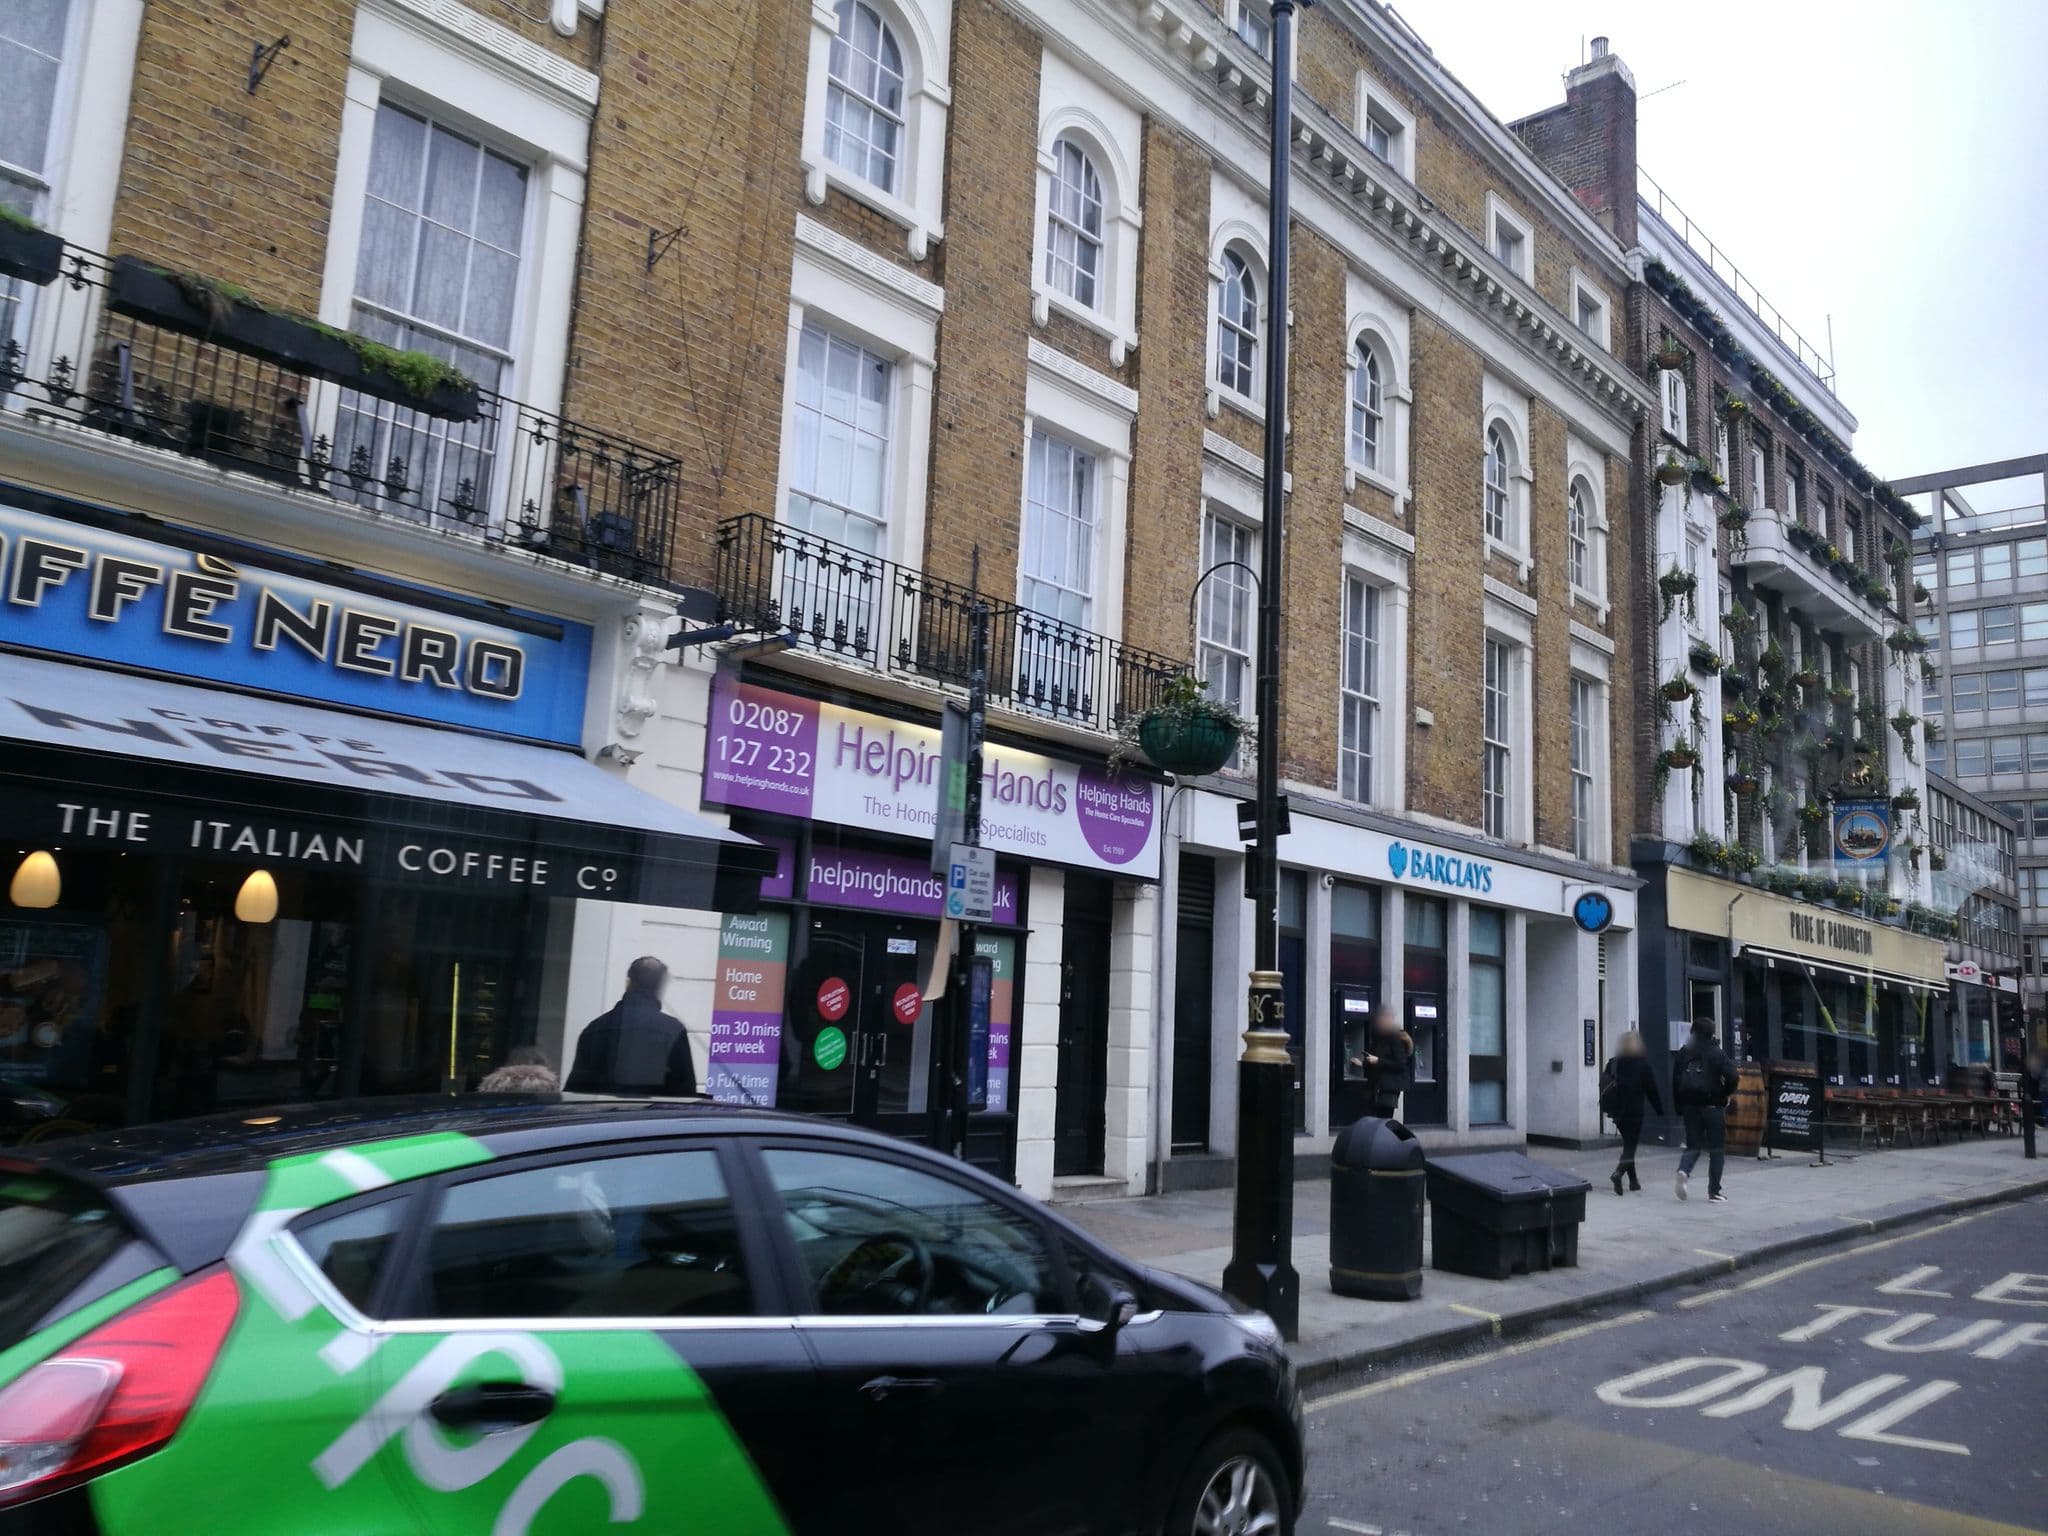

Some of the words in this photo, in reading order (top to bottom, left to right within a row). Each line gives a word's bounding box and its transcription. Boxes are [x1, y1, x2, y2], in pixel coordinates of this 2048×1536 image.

[0, 531, 240, 644] FFÈ
[254, 587, 525, 700] NERO
[730, 699, 804, 737] 02087
[8, 698, 566, 802] NERO
[717, 736, 762, 766] 127
[767, 746, 811, 777] 232
[837, 722, 942, 793] Helpin
[713, 771, 810, 796] www.helpinghands.co.uk
[1079, 784, 1118, 811] Helping
[1120, 793, 1151, 815] Hands
[864, 796, 891, 817] The
[896, 803, 938, 826] Home
[980, 818, 1047, 846] Specialists
[1085, 807, 1094, 817] The
[1109, 811, 1120, 822] Care
[57, 803, 150, 842] THE
[191, 820, 364, 866] ITALIAN
[398, 844, 548, 887] COFFEE
[953, 867, 965, 889] P
[1411, 848, 1493, 893] BARCLAYS
[729, 916, 768, 932] Award
[1790, 911, 1814, 944] PRIDE
[1816, 918, 1826, 946] OF
[1828, 920, 1873, 956] PADDINGTON
[722, 932, 773, 953] Winning
[975, 942, 998, 954] ward
[726, 968, 762, 984] Home
[729, 986, 757, 1001] Care
[733, 1021, 750, 1036] 30
[752, 1024, 780, 1037] mins
[711, 1043, 732, 1057] per
[735, 1040, 765, 1054] week
[1779, 1092, 1810, 1105] OPEN
